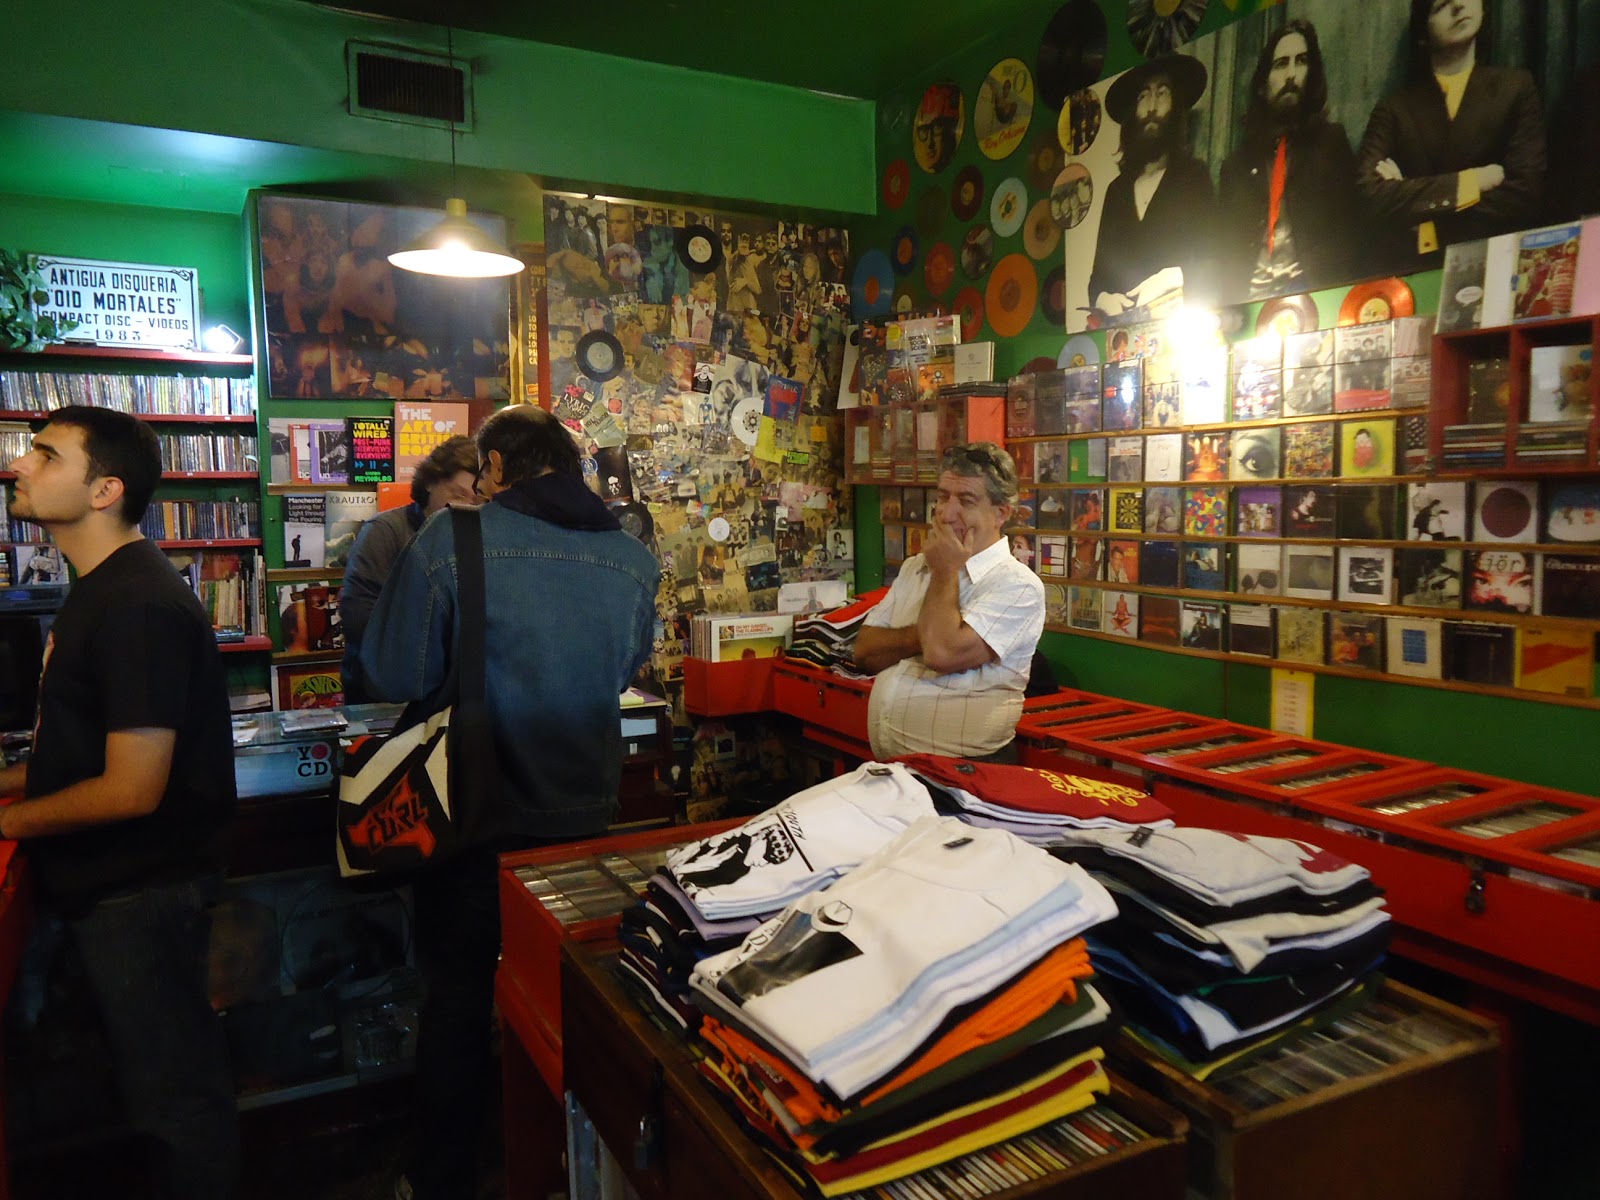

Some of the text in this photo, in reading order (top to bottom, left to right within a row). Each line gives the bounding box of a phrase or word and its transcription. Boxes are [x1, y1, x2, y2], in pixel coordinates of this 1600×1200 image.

[50, 268, 178, 294] ANTIGUA DISQUERIA
[104, 314, 131, 327] DISC
[148, 317, 189, 330] VIDEOS
[400, 408, 432, 420] THE
[353, 422, 390, 430] TOTALLY
[401, 421, 457, 432] ART OF
[353, 430, 391, 438] WIRED:
[297, 761, 328, 777] CD
